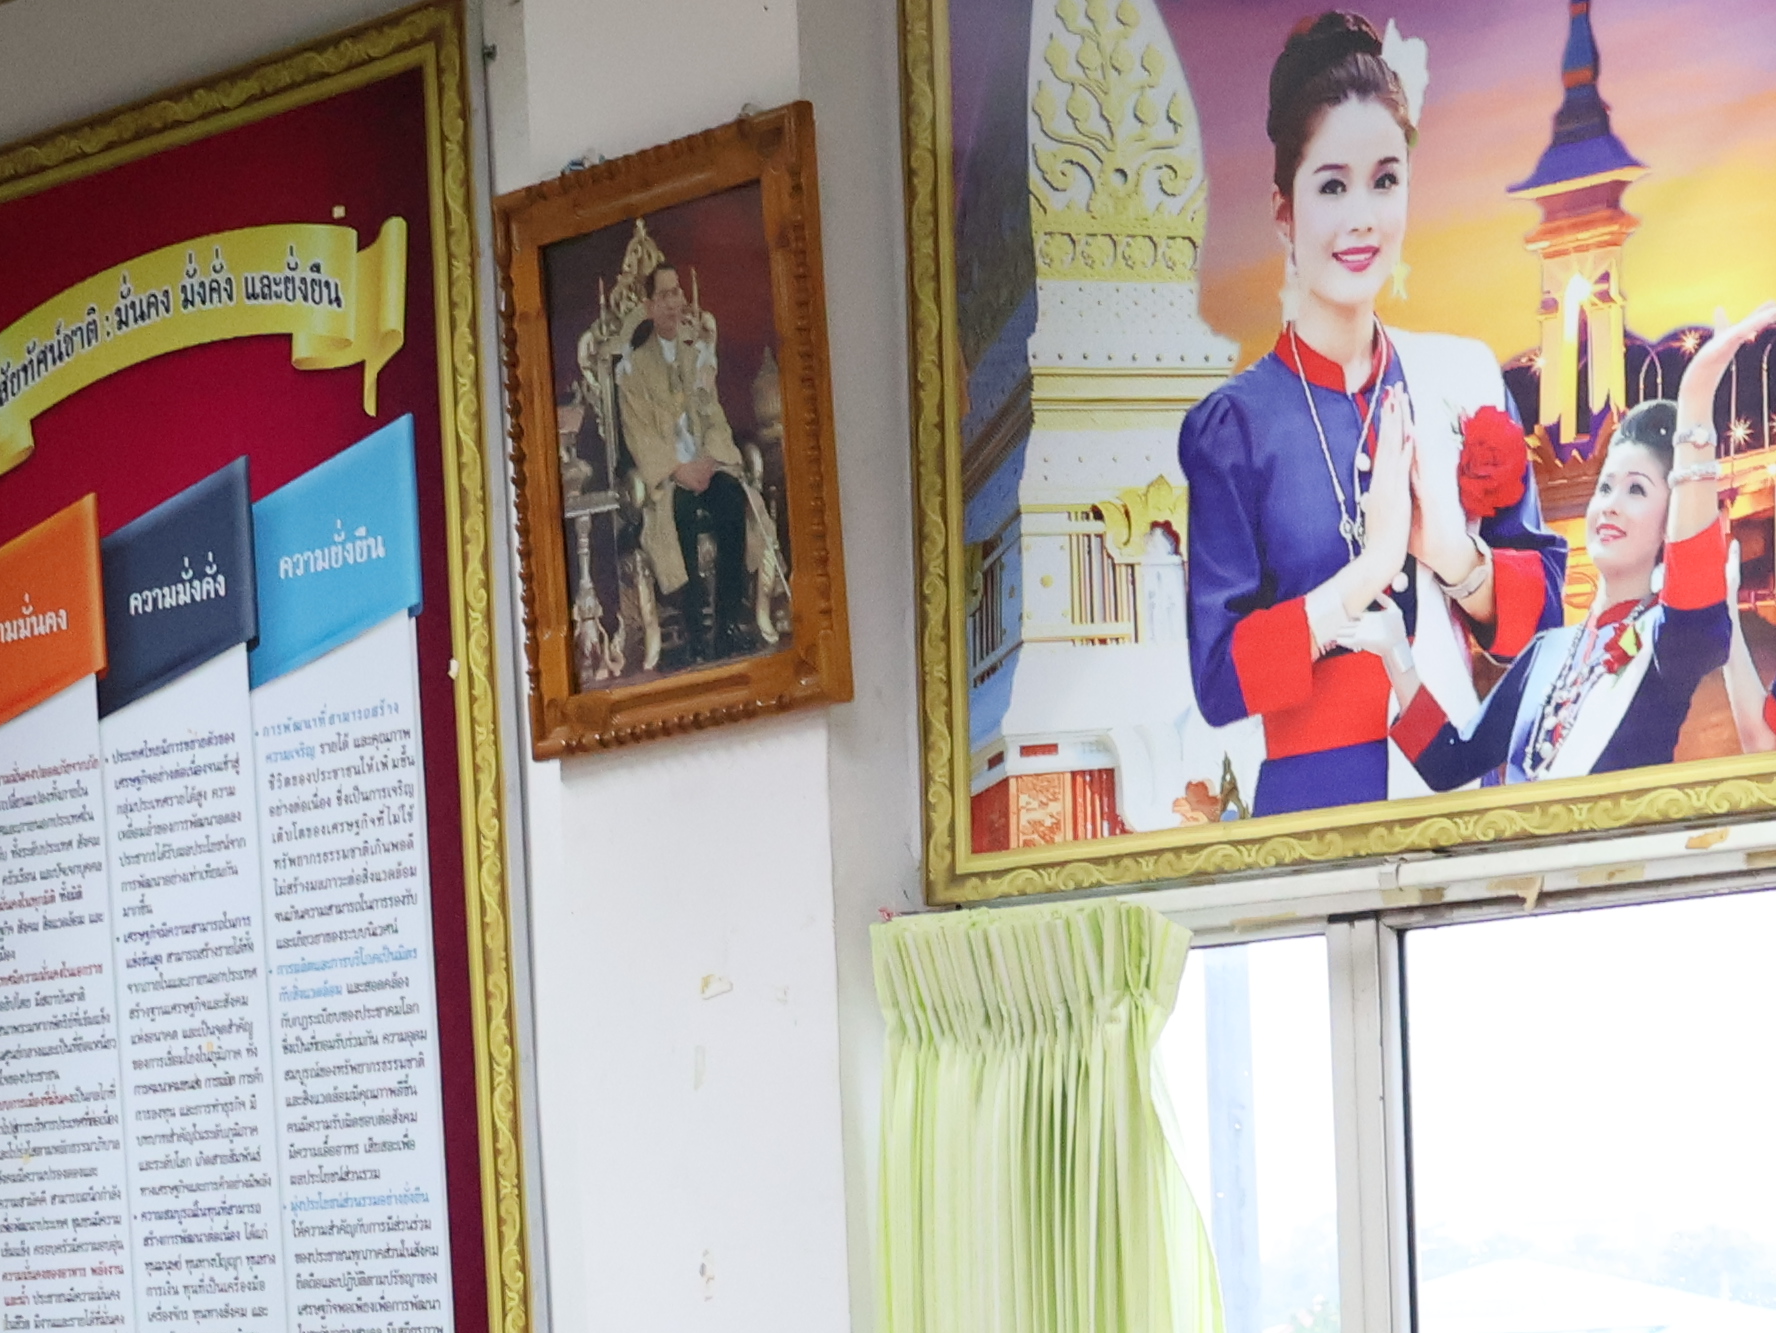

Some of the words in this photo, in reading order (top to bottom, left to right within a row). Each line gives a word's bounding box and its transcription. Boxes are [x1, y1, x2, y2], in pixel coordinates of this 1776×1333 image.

[114, 272, 171, 332] มั่นคง
[180, 247, 236, 307] มั่งคั่ง
[244, 245, 342, 309] และยั่งยืน
[279, 517, 386, 581] ความยั่งยืน
[129, 552, 226, 617] ความมั่งคั่ง
